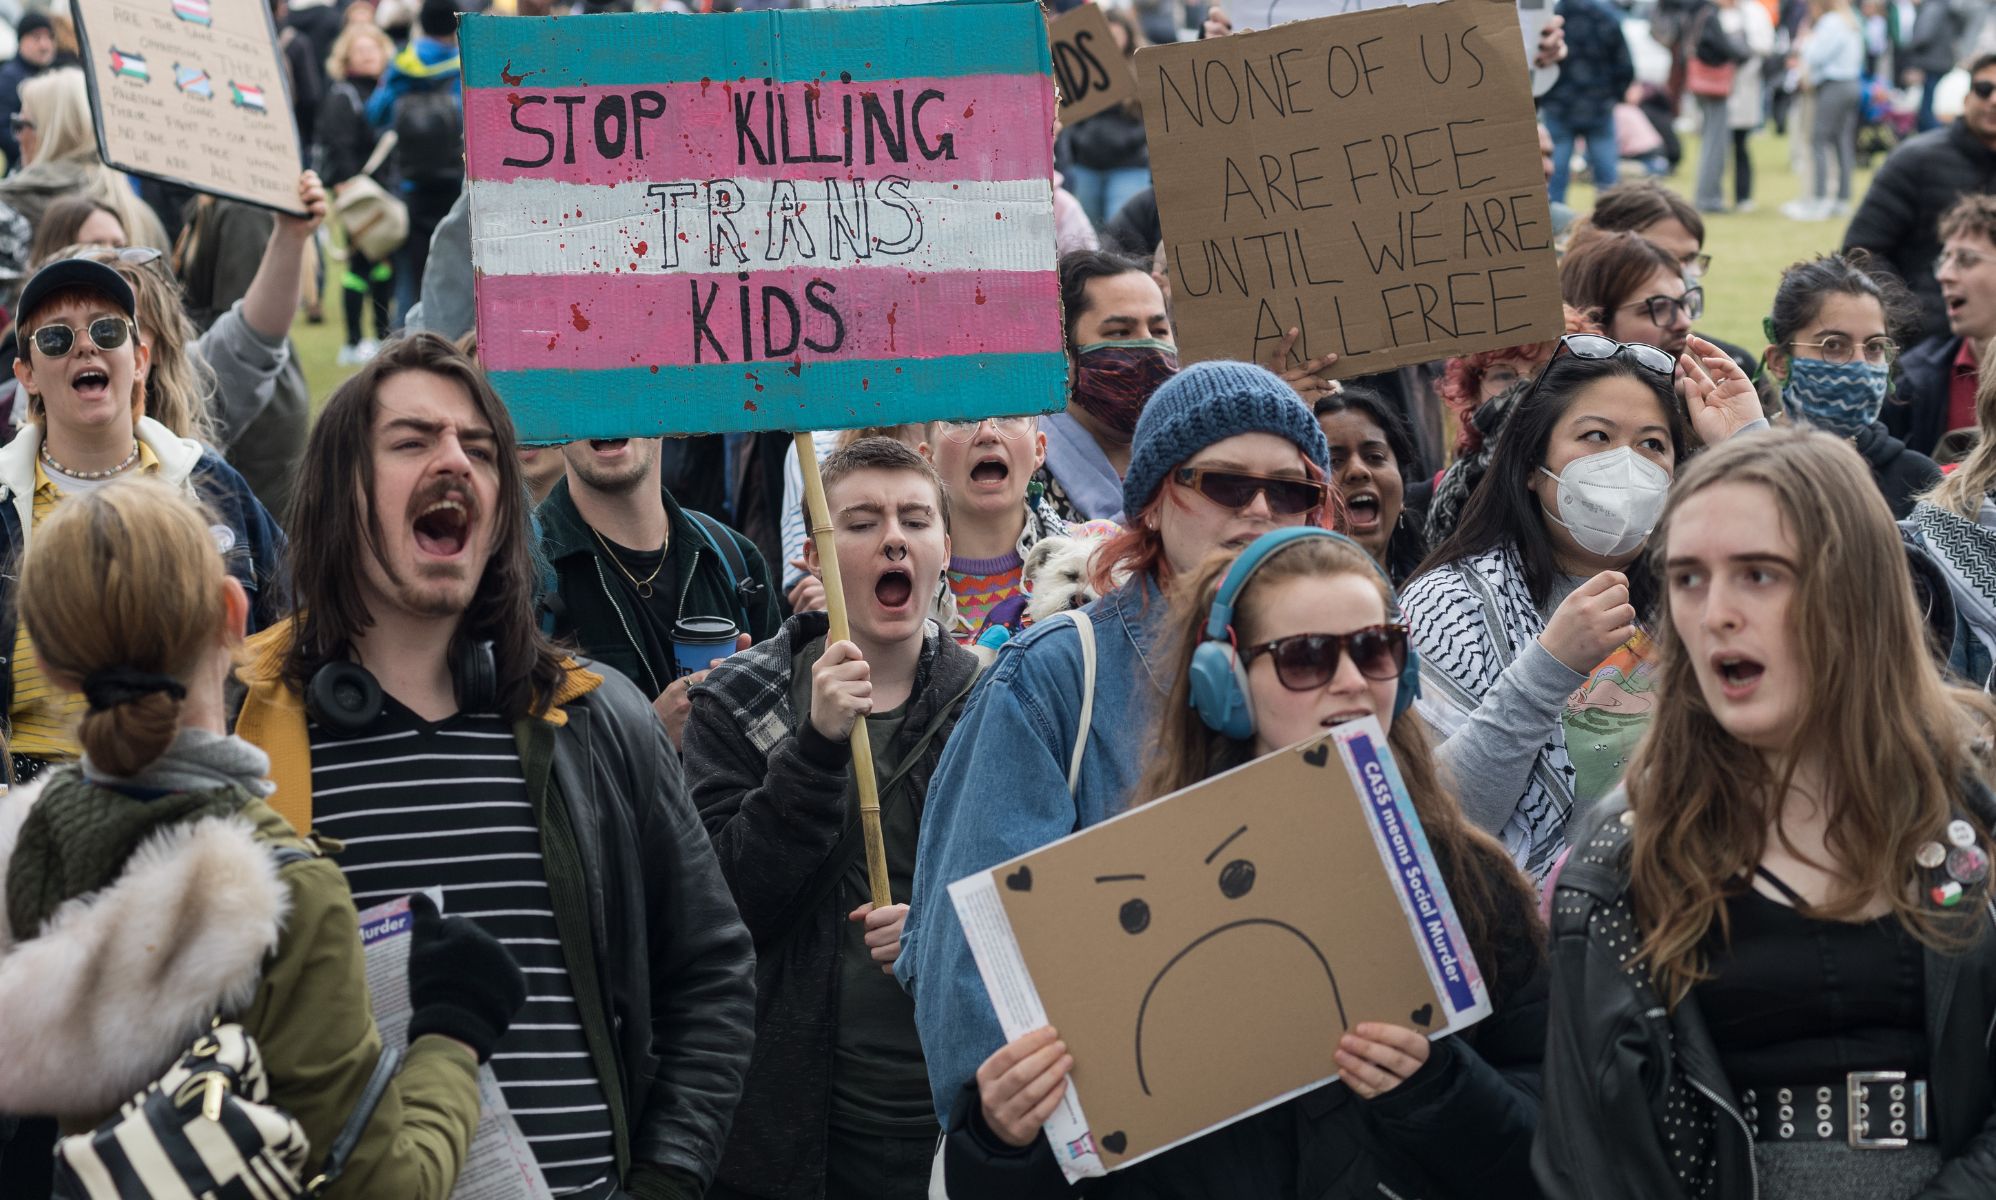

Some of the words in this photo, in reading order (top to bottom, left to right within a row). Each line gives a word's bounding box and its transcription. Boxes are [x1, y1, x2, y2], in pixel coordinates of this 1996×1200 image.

[1051, 30, 1111, 108] IDS
[1158, 48, 1314, 134] NONE
[1327, 36, 1385, 99] OF
[1420, 26, 1484, 89] US
[502, 90, 667, 169] STOP
[1223, 147, 1333, 223] ARE
[1343, 118, 1496, 204] FREE
[647, 174, 924, 269] TRANS
[1176, 229, 1344, 298] UNTIL
[1352, 202, 1448, 275] WE
[1463, 194, 1550, 260] ARE
[1253, 296, 1371, 364] ALL
[1381, 266, 1532, 348] FREE
[1364, 761, 1392, 806] CASS
[1382, 808, 1412, 866] means
[1405, 865, 1438, 919] Social
[1427, 920, 1461, 984] Murder
